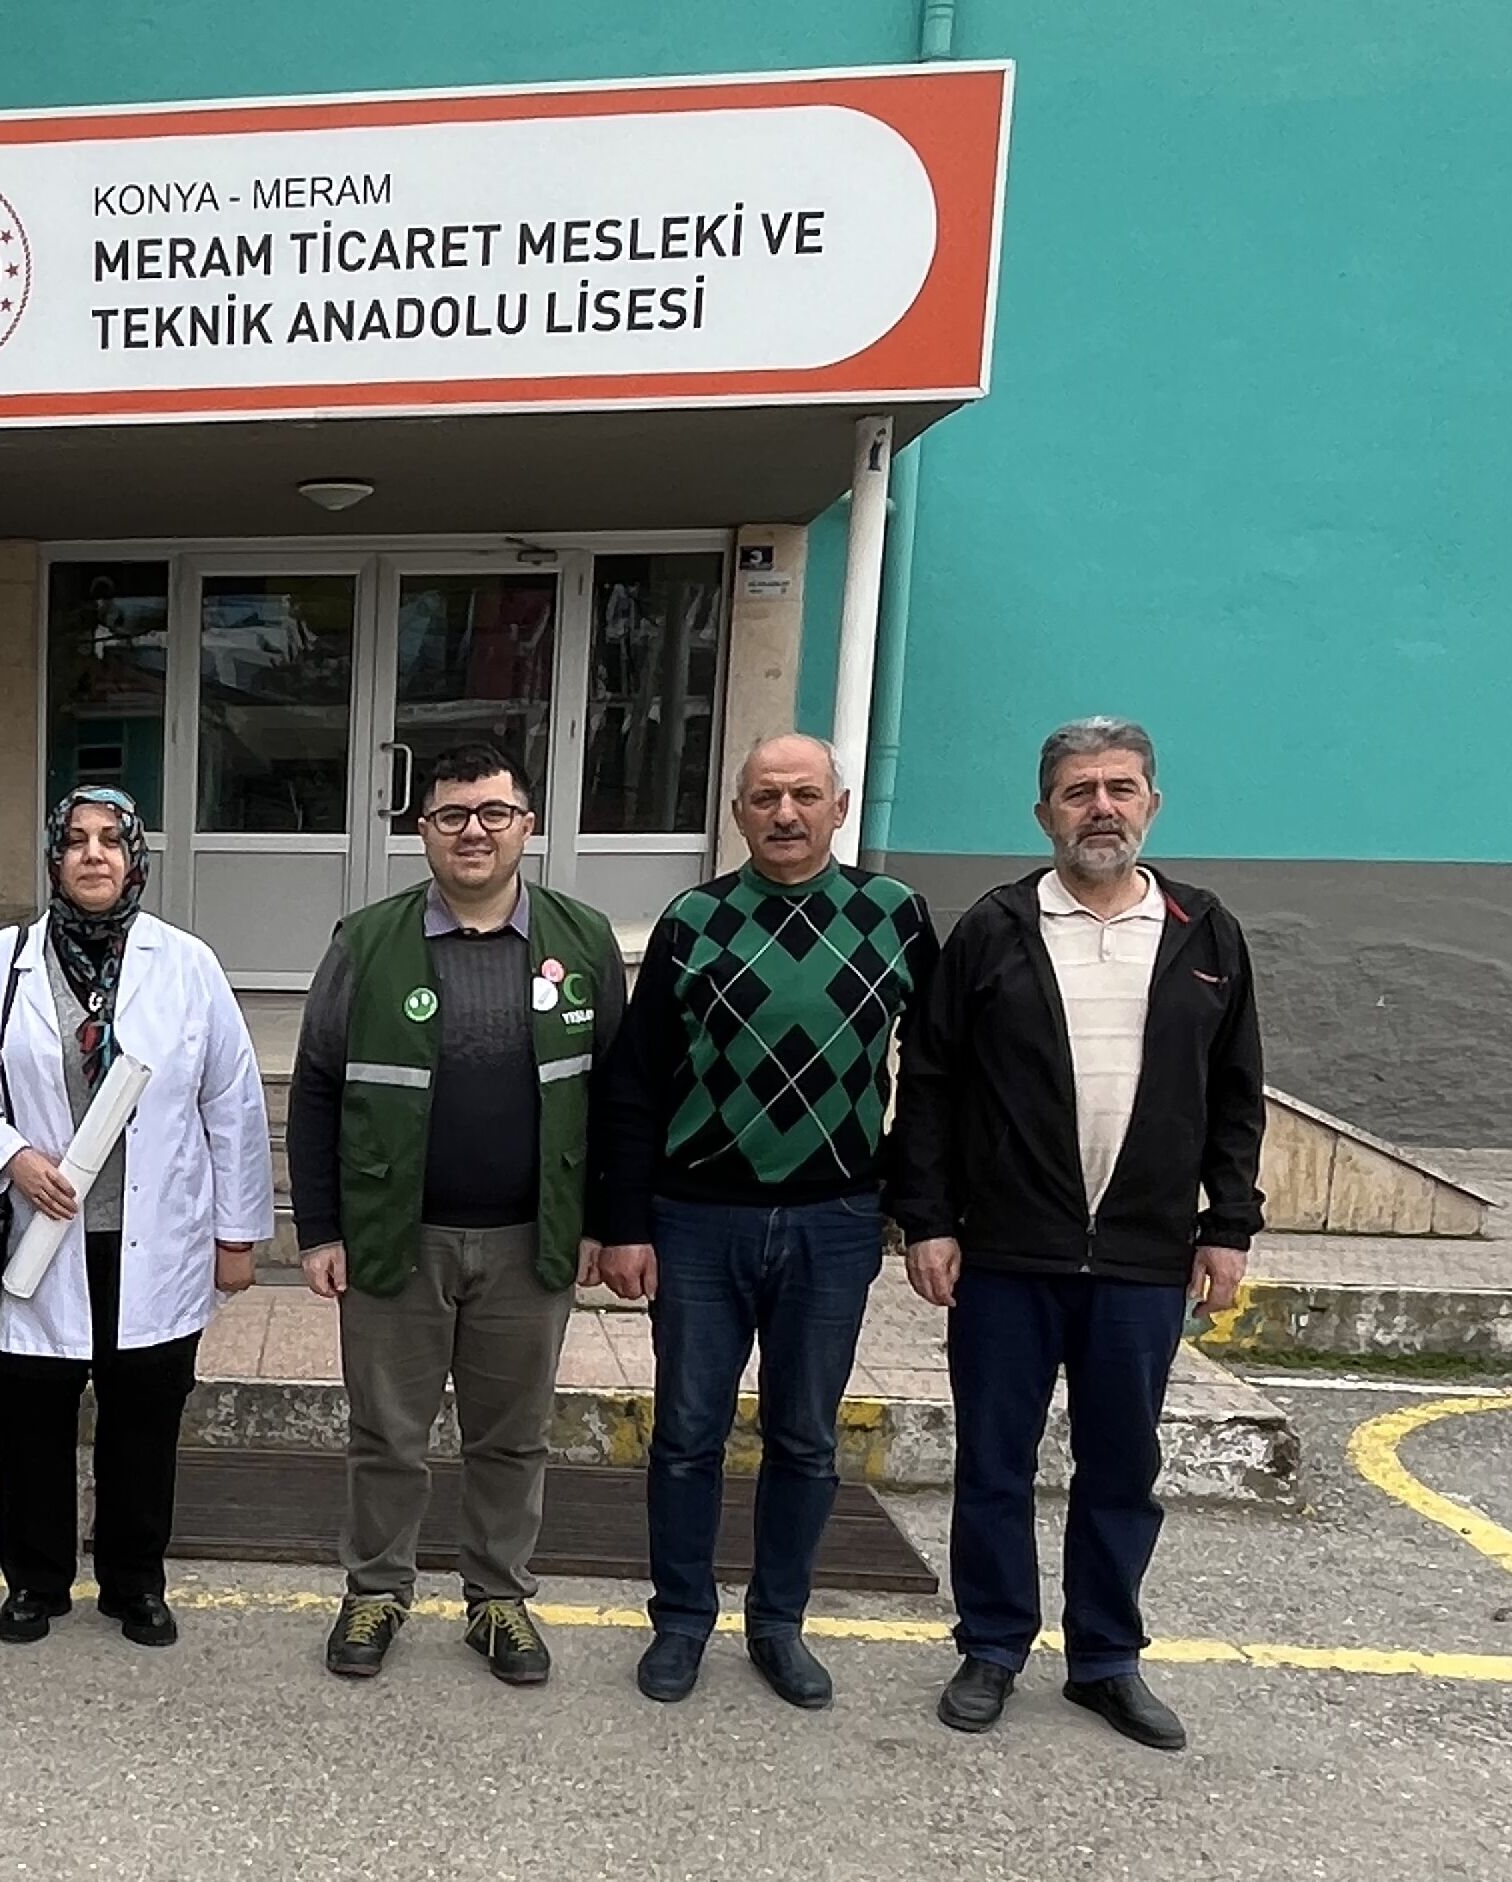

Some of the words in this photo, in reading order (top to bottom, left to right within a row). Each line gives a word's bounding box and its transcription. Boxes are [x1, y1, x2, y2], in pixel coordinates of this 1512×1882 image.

[94, 181, 220, 216] KONYA
[253, 173, 391, 210] MERAM
[94, 234, 273, 282] MERAM
[290, 220, 502, 274] TİCARET
[517, 202, 744, 265] MESLEKİ
[761, 211, 825, 255] VE
[91, 293, 273, 350] TEKNİK
[287, 293, 527, 343] ANADOLU
[546, 274, 705, 333] LİSESİ
